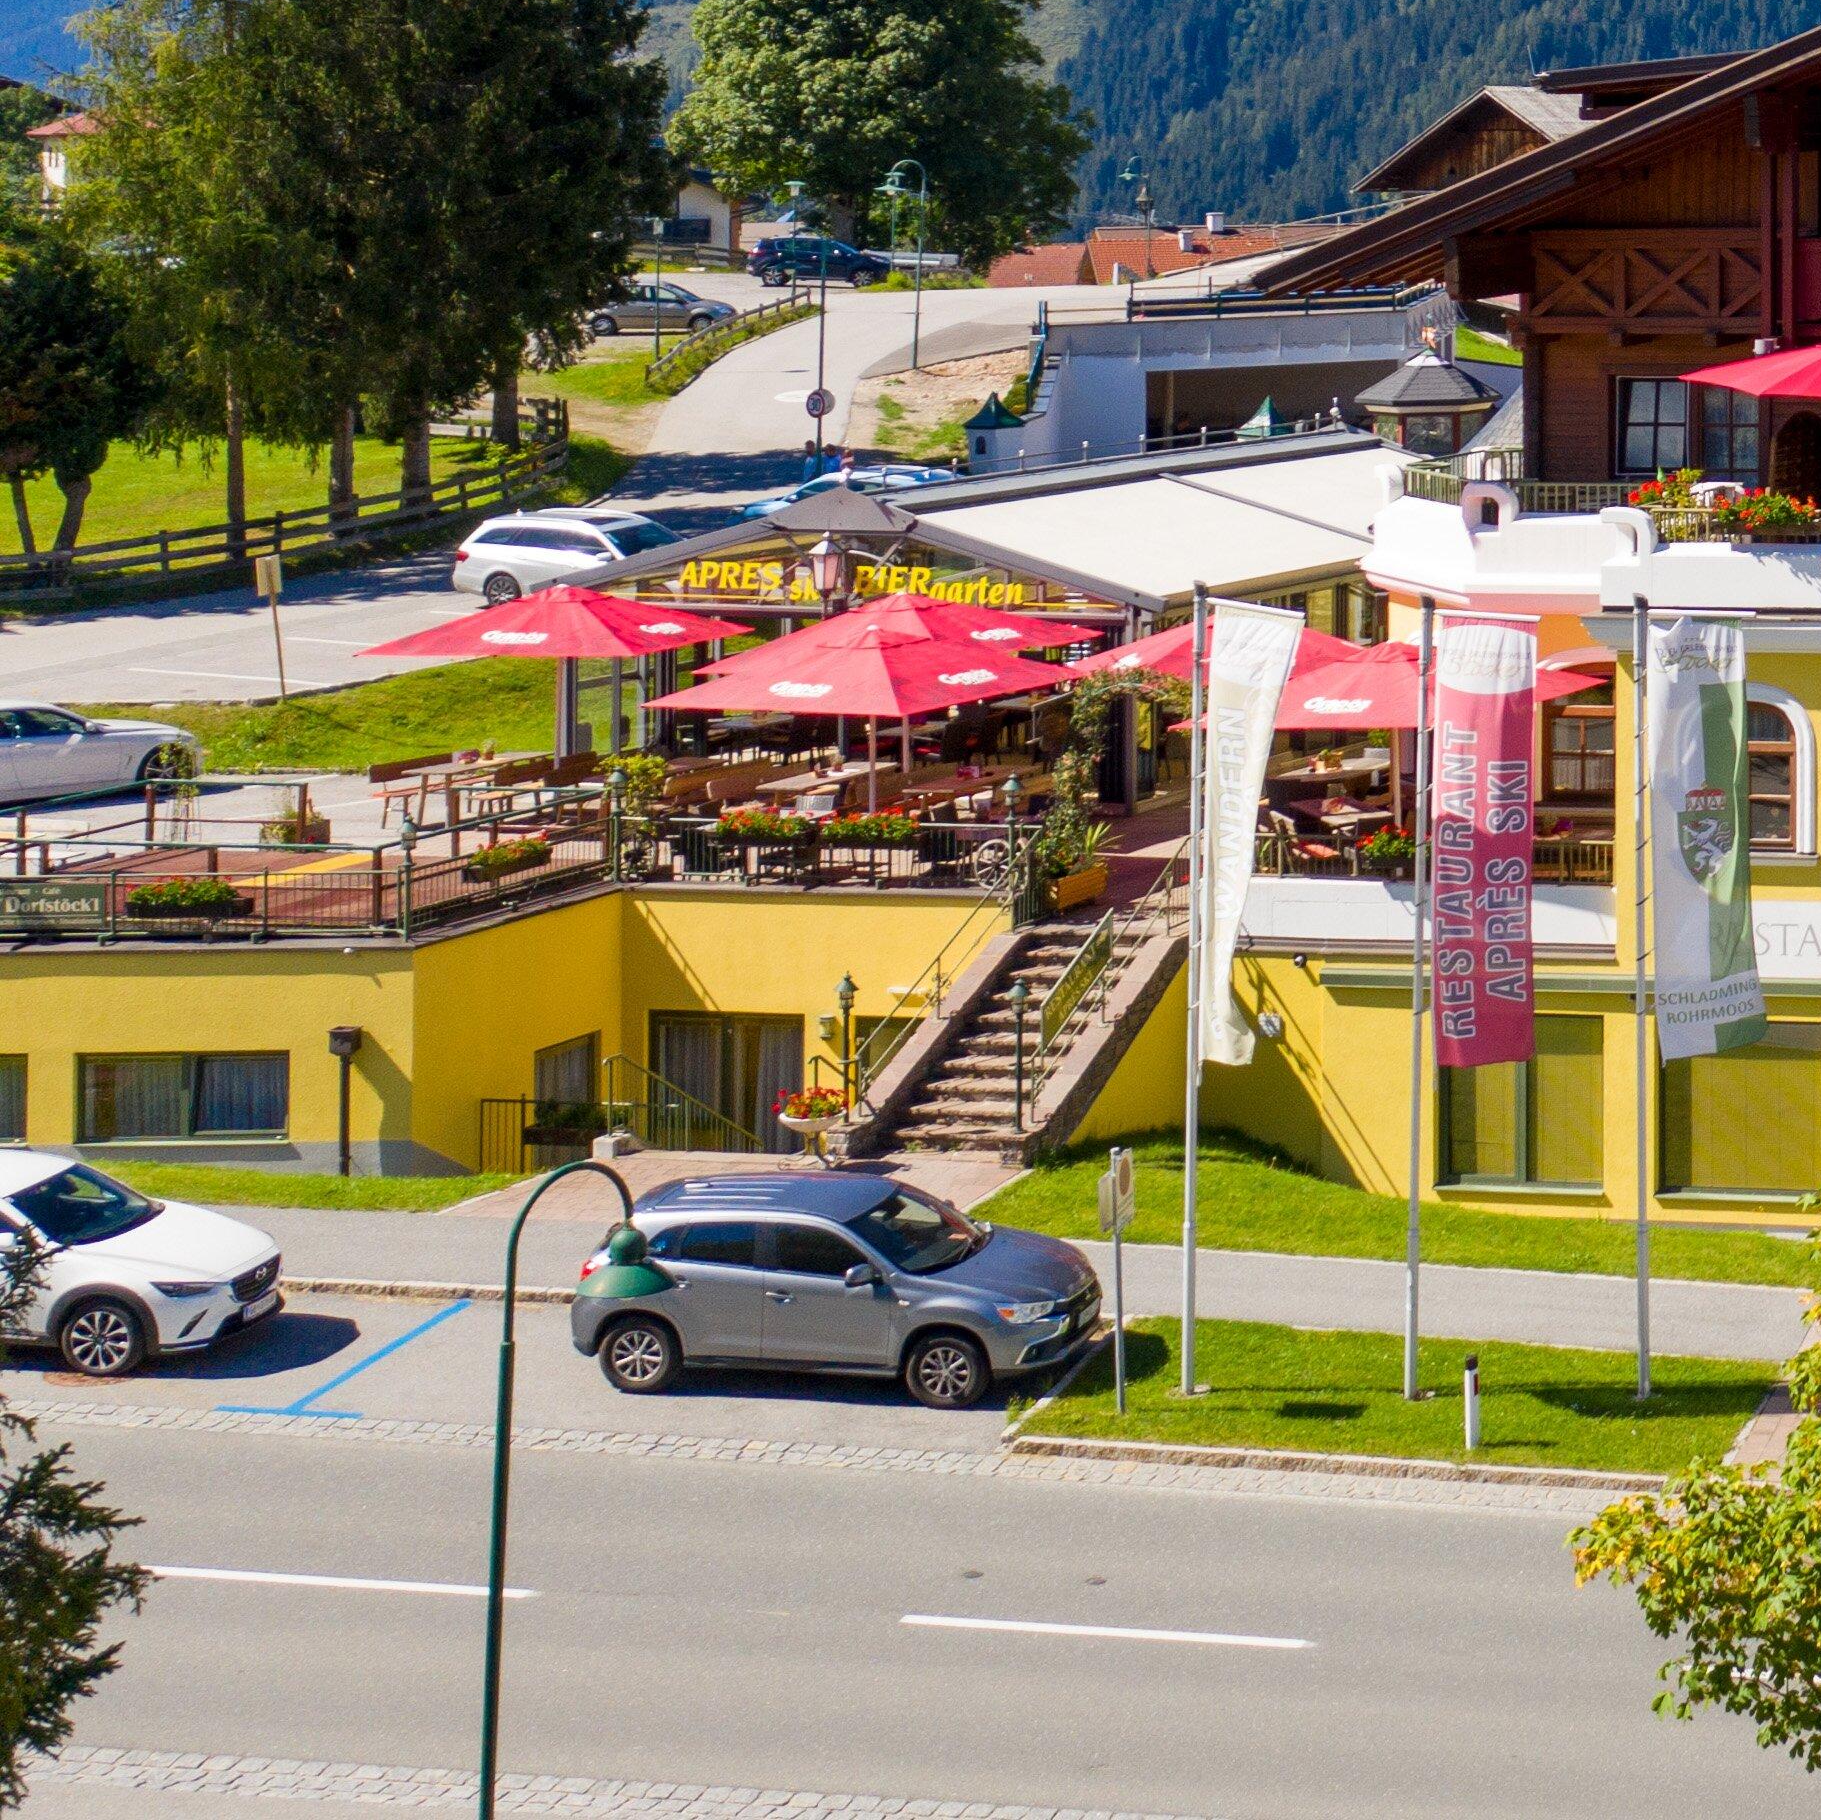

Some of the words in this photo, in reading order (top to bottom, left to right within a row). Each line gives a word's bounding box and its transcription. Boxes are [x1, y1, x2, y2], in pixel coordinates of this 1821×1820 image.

[678, 560, 783, 590] APRES
[1214, 708, 1246, 920] WANDERN
[1486, 759, 1529, 836] SKI
[1436, 720, 1478, 1039] RESTAURANT
[1474, 856, 1528, 1002] APRÈS
[1657, 978, 1758, 1007] SCHLADMING
[1666, 998, 1755, 1025] ROHRMOOS
